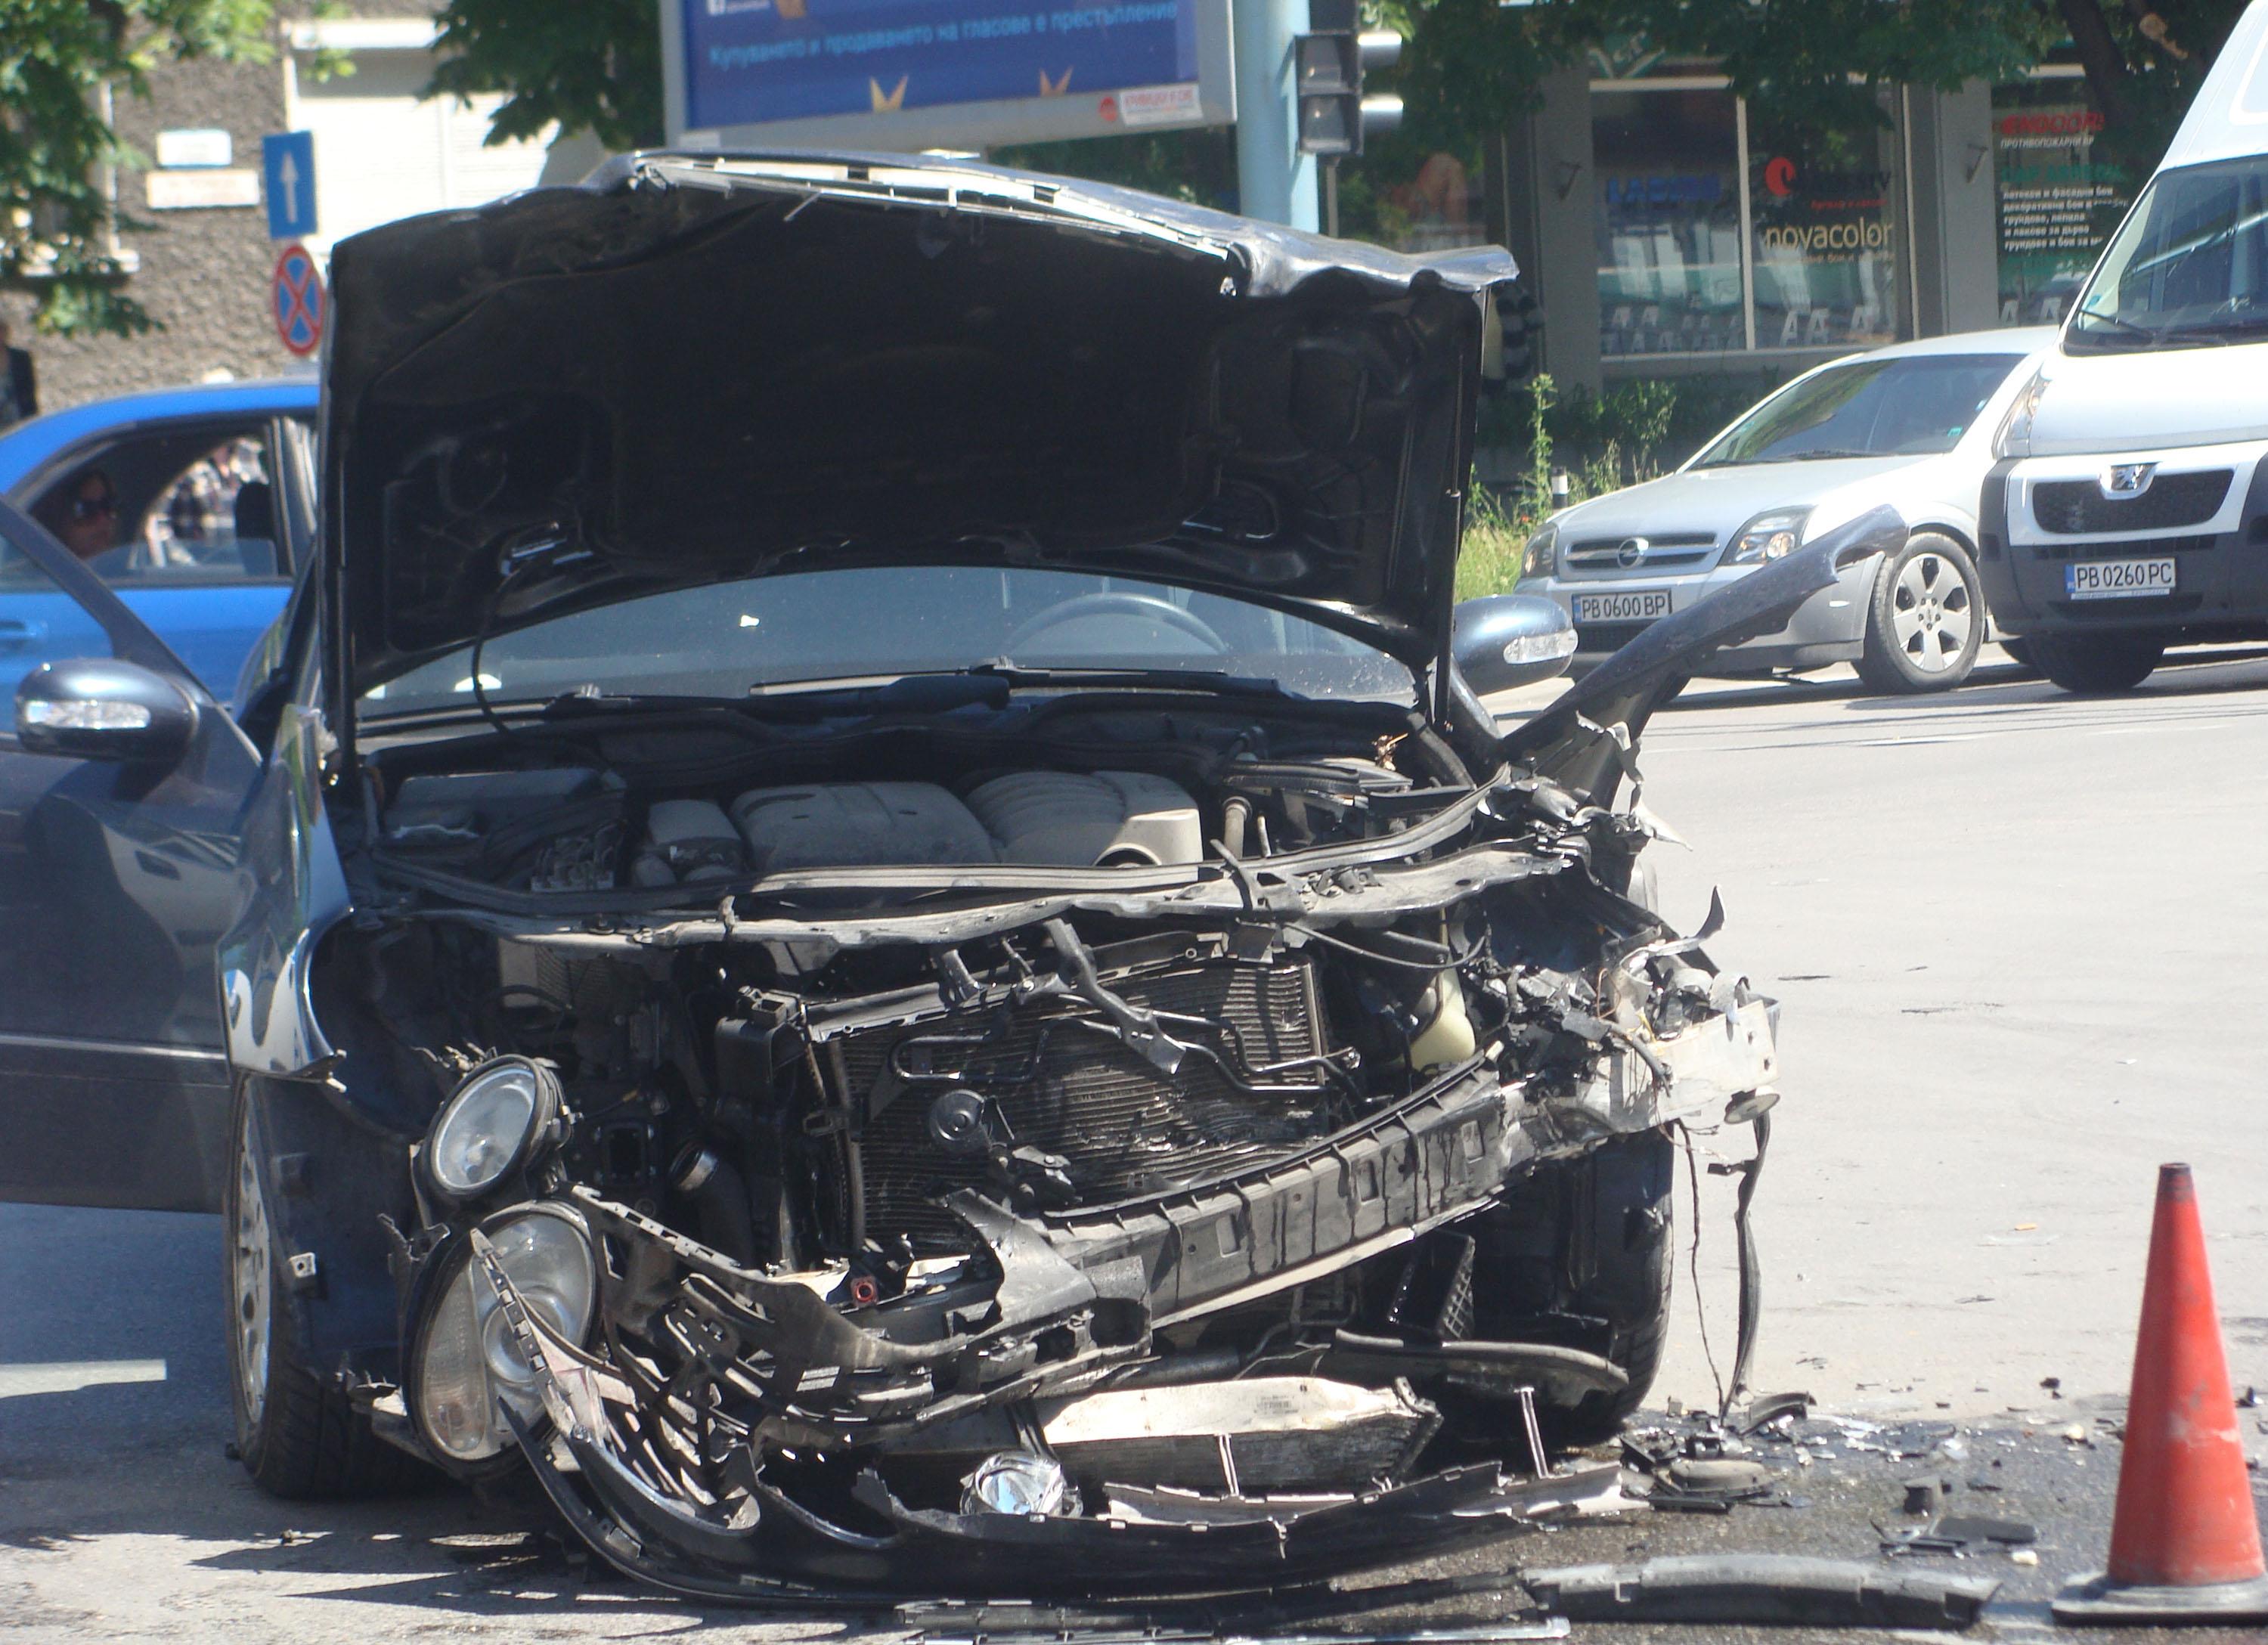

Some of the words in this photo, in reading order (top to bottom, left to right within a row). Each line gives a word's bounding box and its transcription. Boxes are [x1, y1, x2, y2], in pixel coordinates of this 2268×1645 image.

[1765, 217, 1892, 251] novacolor
[2077, 566, 2099, 588] PB
[2103, 564, 2145, 587] 0260
[2149, 562, 2171, 584] PC
[1582, 598, 1600, 618] PB
[1603, 594, 1641, 617] 0600
[1644, 595, 1666, 615] BP
